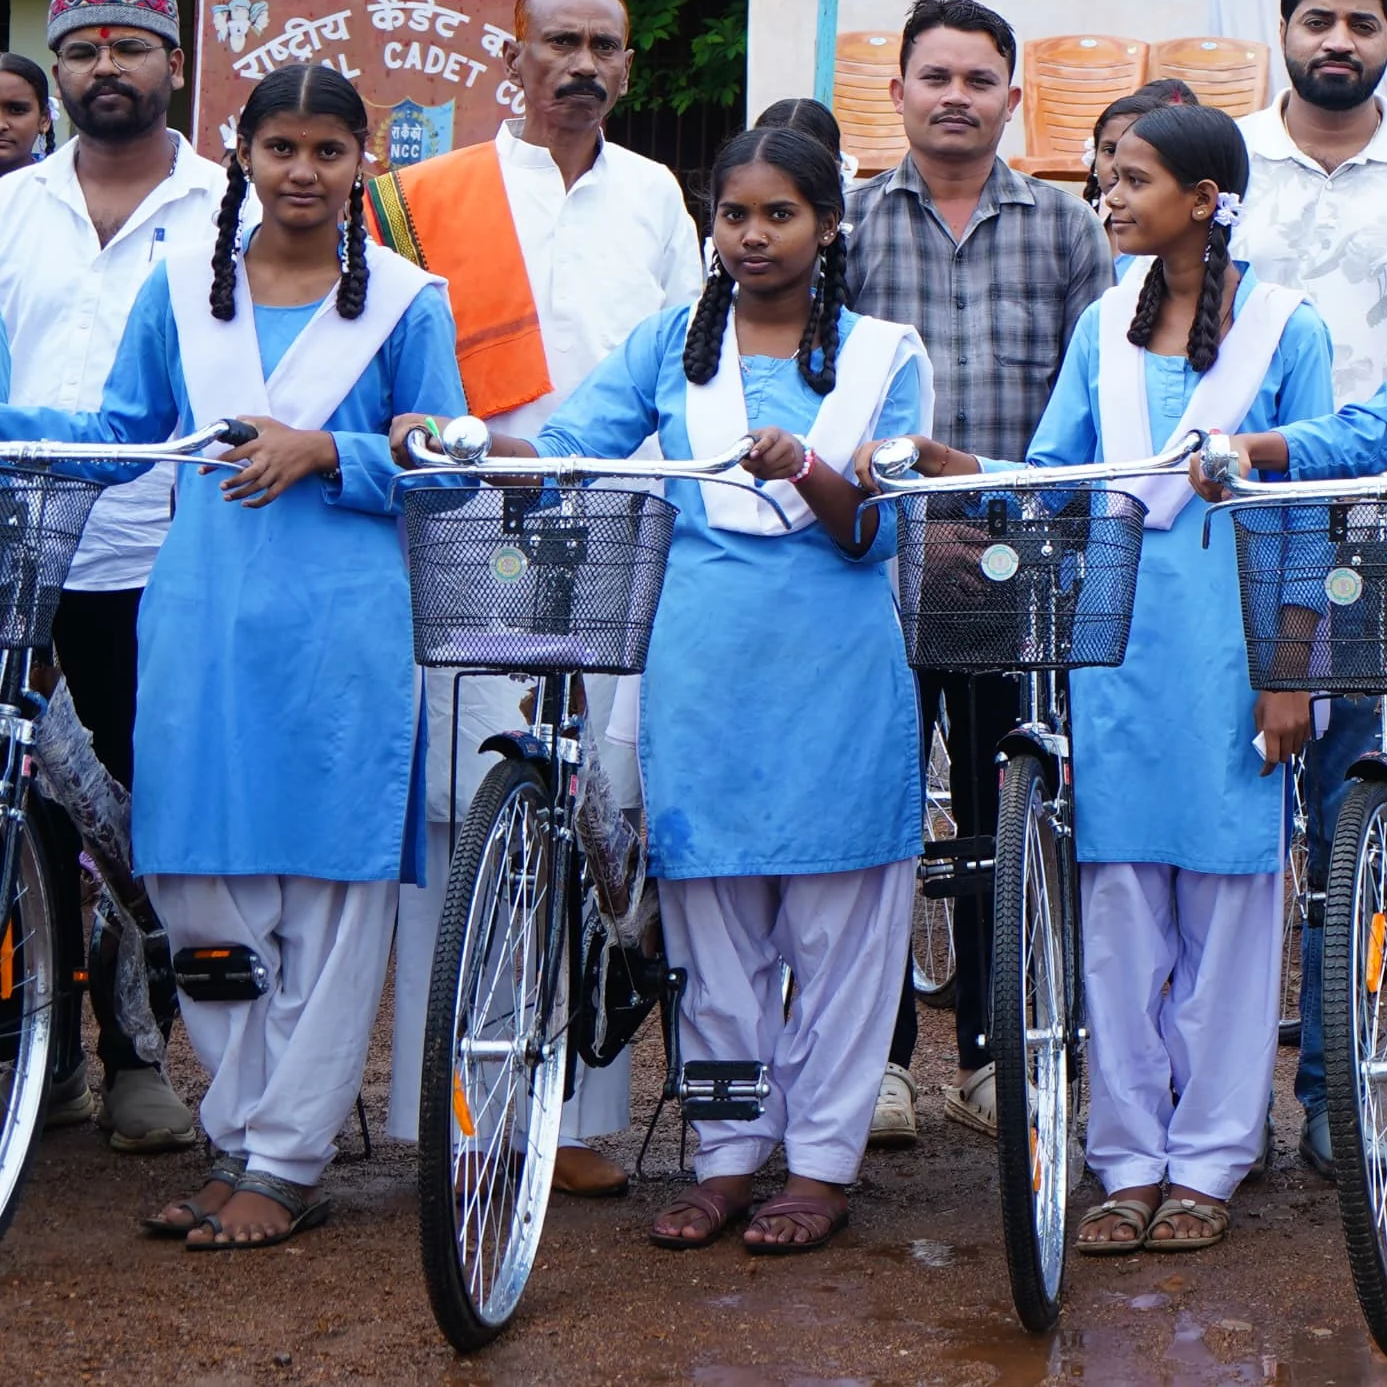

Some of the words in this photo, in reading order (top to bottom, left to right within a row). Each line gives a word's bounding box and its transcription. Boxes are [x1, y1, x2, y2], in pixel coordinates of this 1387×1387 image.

[232, 9, 352, 81] राष्ट्रीय
[384, 41, 488, 88] CADET
[390, 143, 420, 159] NCC
